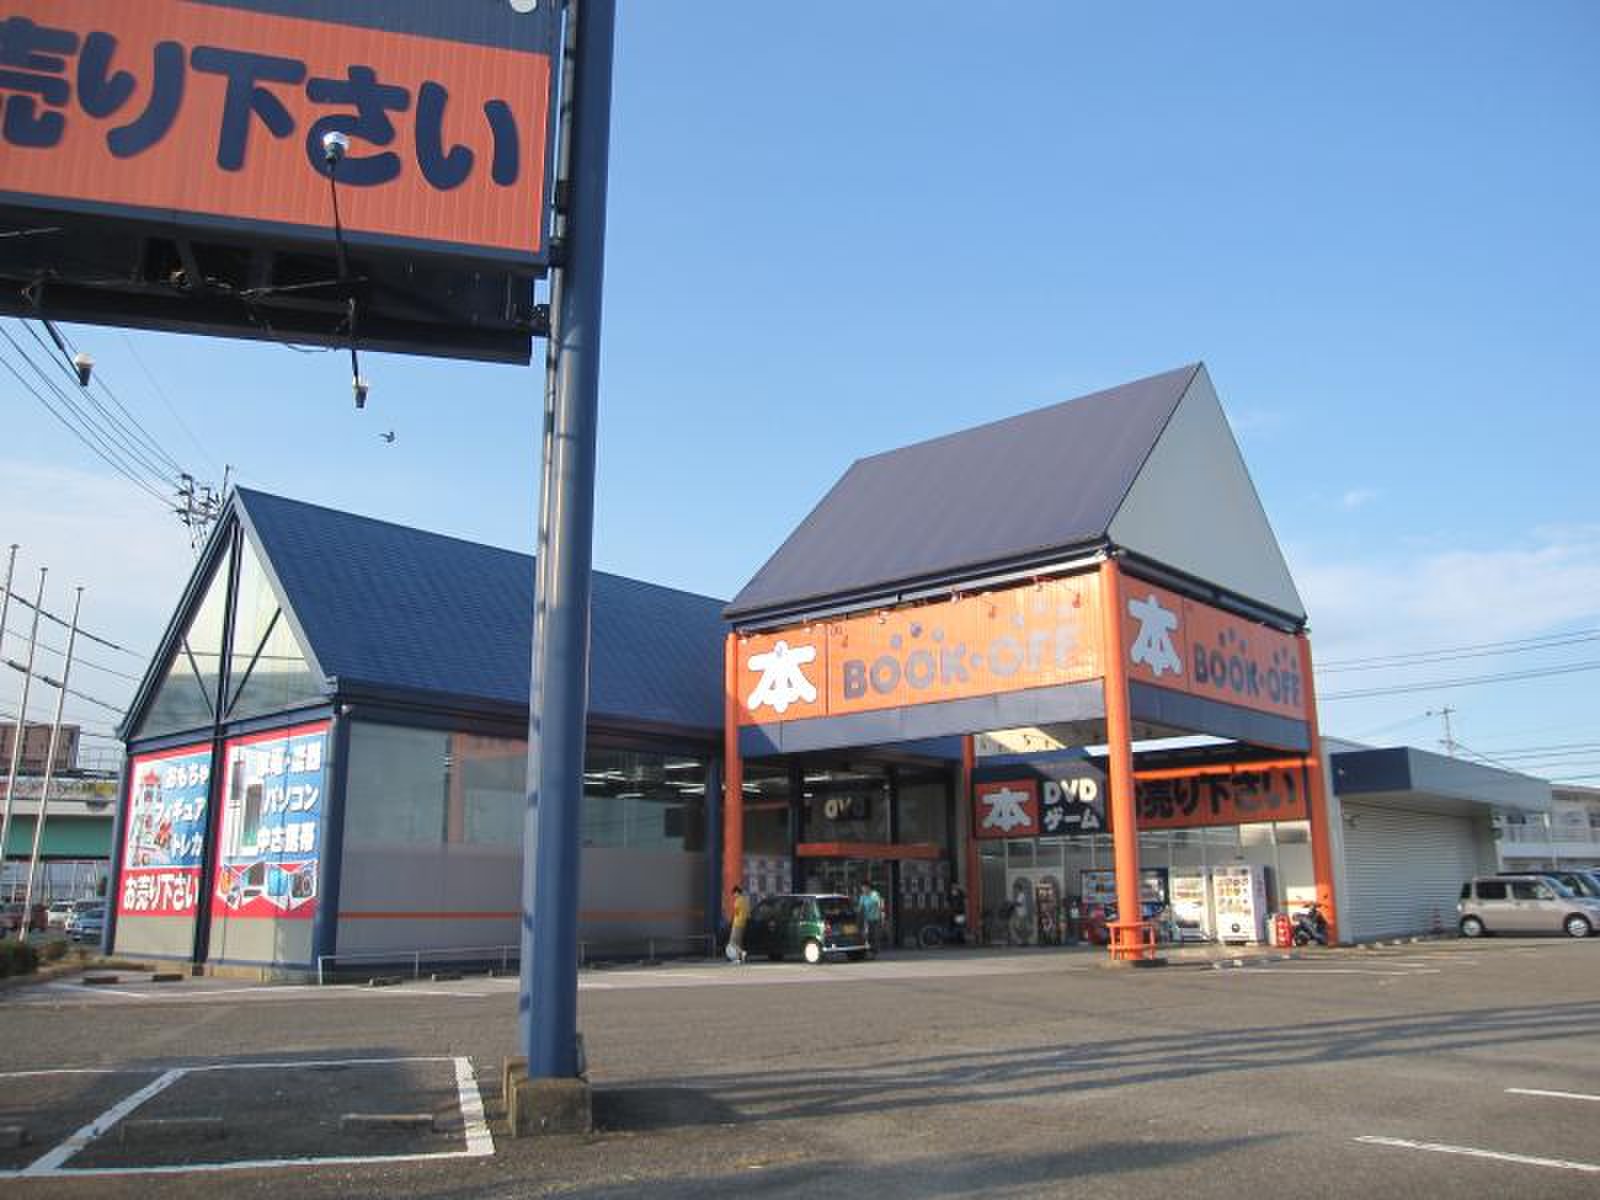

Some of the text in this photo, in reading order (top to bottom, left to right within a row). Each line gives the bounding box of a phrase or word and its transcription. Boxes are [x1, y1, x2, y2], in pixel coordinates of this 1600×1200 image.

[0, 16, 521, 191] 売り下さい
[1044, 778, 1098, 805] DVD
[1043, 807, 1100, 831] ゲーム
[123, 873, 199, 910] お売り下さい
